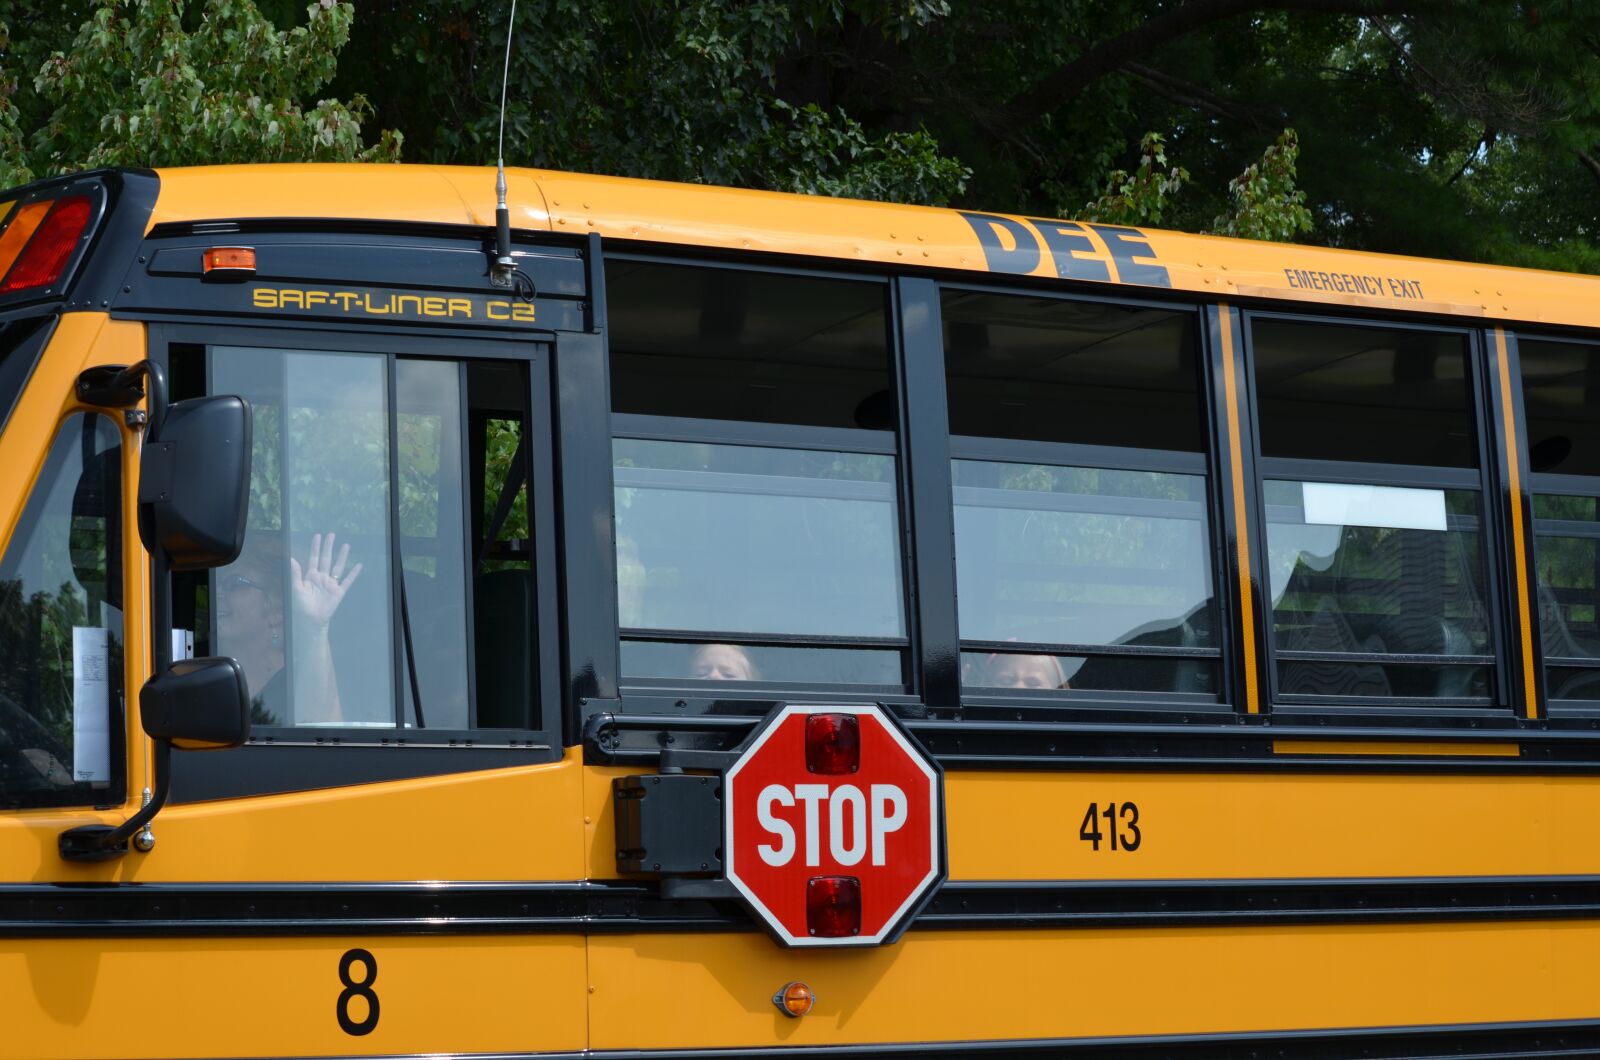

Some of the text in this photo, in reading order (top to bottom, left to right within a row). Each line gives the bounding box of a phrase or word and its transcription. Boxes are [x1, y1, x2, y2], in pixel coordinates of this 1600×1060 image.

[955, 211, 1173, 288] DEE
[253, 288, 536, 322] SAF-T-LINER C2
[1284, 268, 1424, 299] EMERGENCY EXIT
[756, 783, 908, 867] STOP
[1079, 801, 1142, 852] 413
[336, 948, 381, 1037] 8
